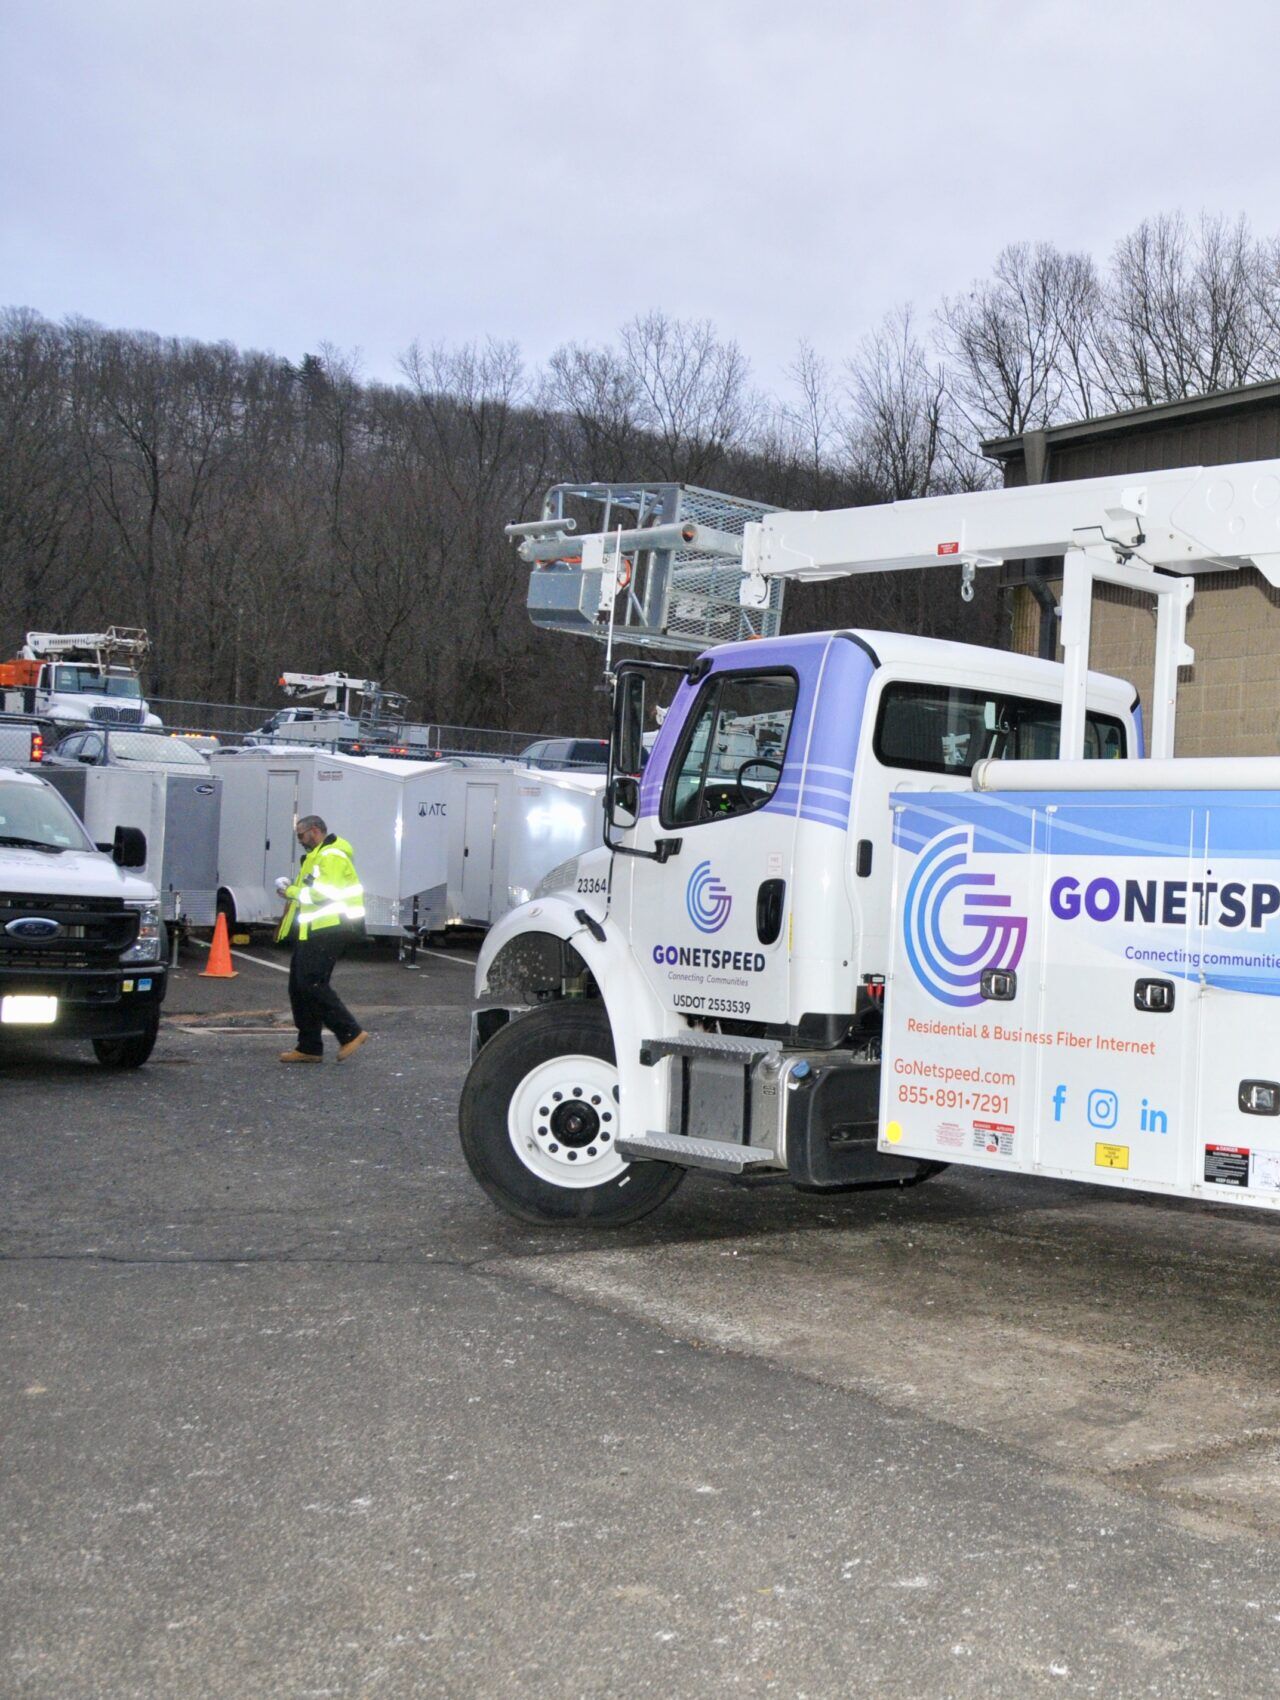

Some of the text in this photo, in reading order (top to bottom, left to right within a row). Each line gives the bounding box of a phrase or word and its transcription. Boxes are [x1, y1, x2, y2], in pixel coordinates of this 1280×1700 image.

[429, 803, 447, 816] ATC
[577, 878, 607, 894] 23364
[653, 945, 766, 972] GONETSPEED
[1125, 946, 1200, 967] Connecting
[668, 972, 749, 987] Connecting Communities
[673, 995, 751, 1014] USDOT 2553539
[907, 1018, 1155, 1055] Residential & Business Fiber Internet
[894, 1059, 1016, 1085] GoNetspeed.com
